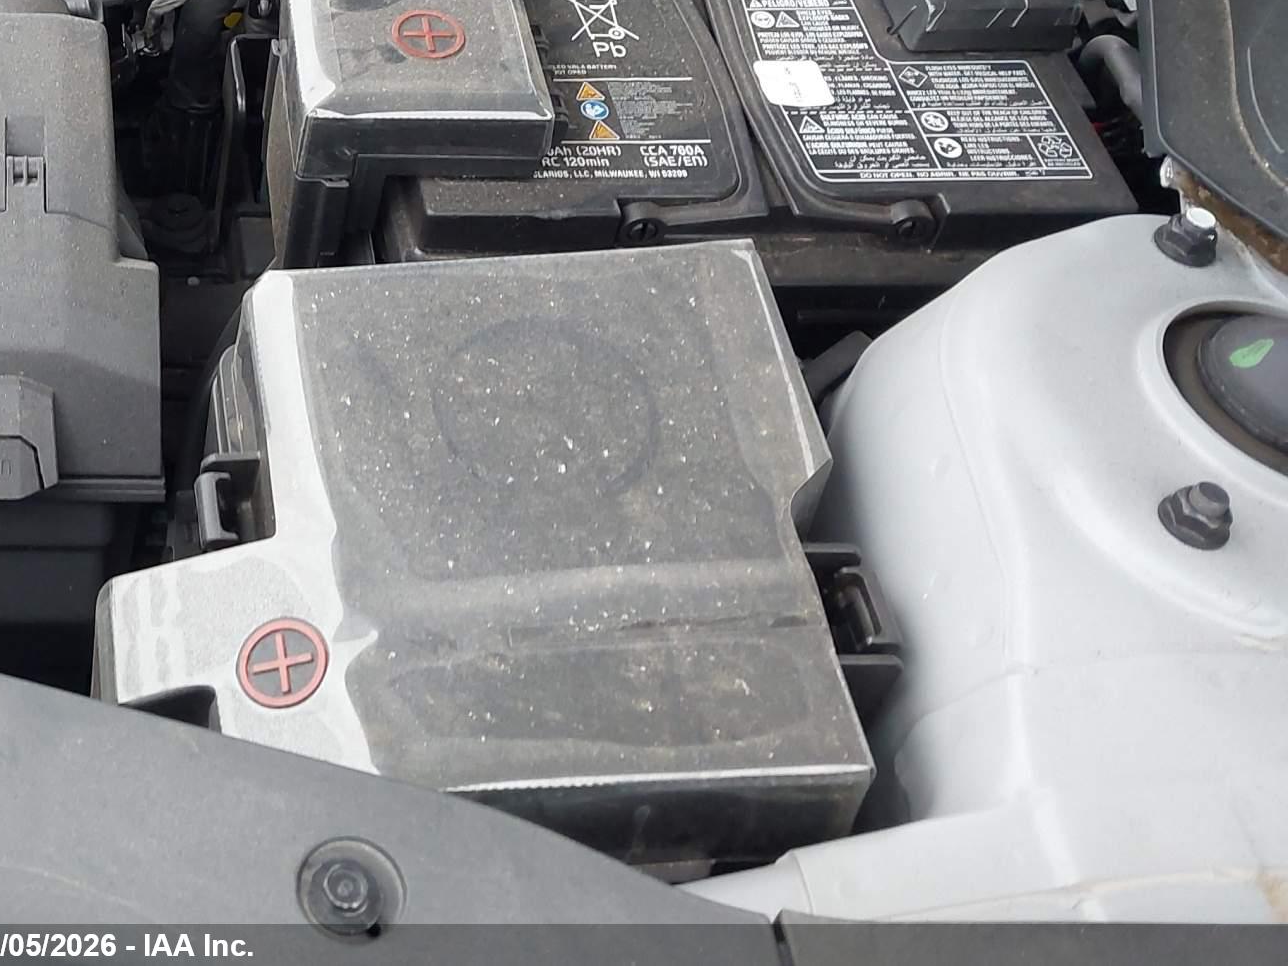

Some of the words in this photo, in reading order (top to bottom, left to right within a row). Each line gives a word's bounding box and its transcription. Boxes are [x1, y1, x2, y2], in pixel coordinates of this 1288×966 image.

[592, 41, 626, 58] Pb
[576, 145, 621, 156] (20HR)
[640, 145, 667, 156] CCA
[542, 157, 560, 167] RC
[565, 157, 610, 167] 120min
